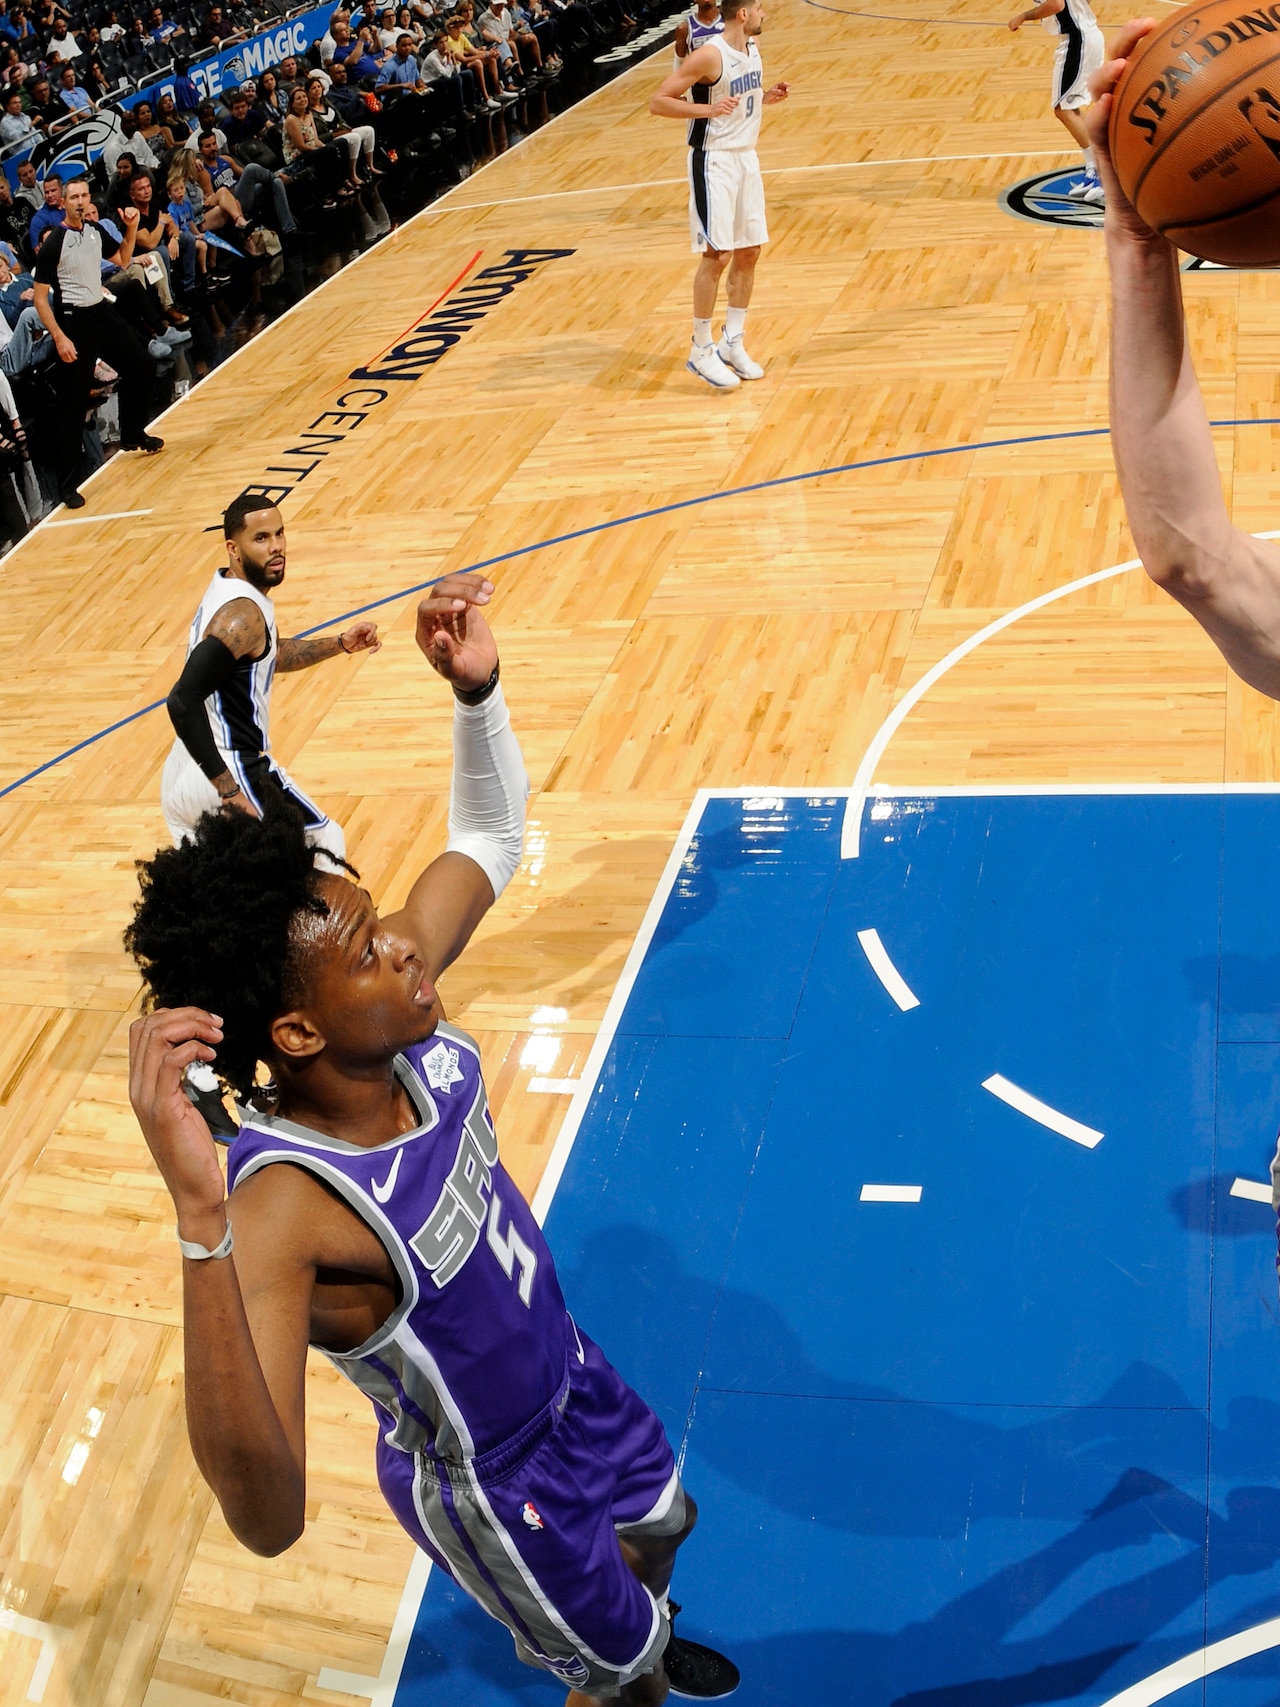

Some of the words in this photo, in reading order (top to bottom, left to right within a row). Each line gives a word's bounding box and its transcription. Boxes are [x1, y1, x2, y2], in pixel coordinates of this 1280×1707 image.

[243, 22, 307, 79] MAGIC
[745, 95, 755, 119] 9
[349, 248, 578, 381] Amway
[440, 1050, 458, 1092] ALMONDS
[408, 1072, 499, 1289] SAC
[485, 1192, 538, 1310] 5
